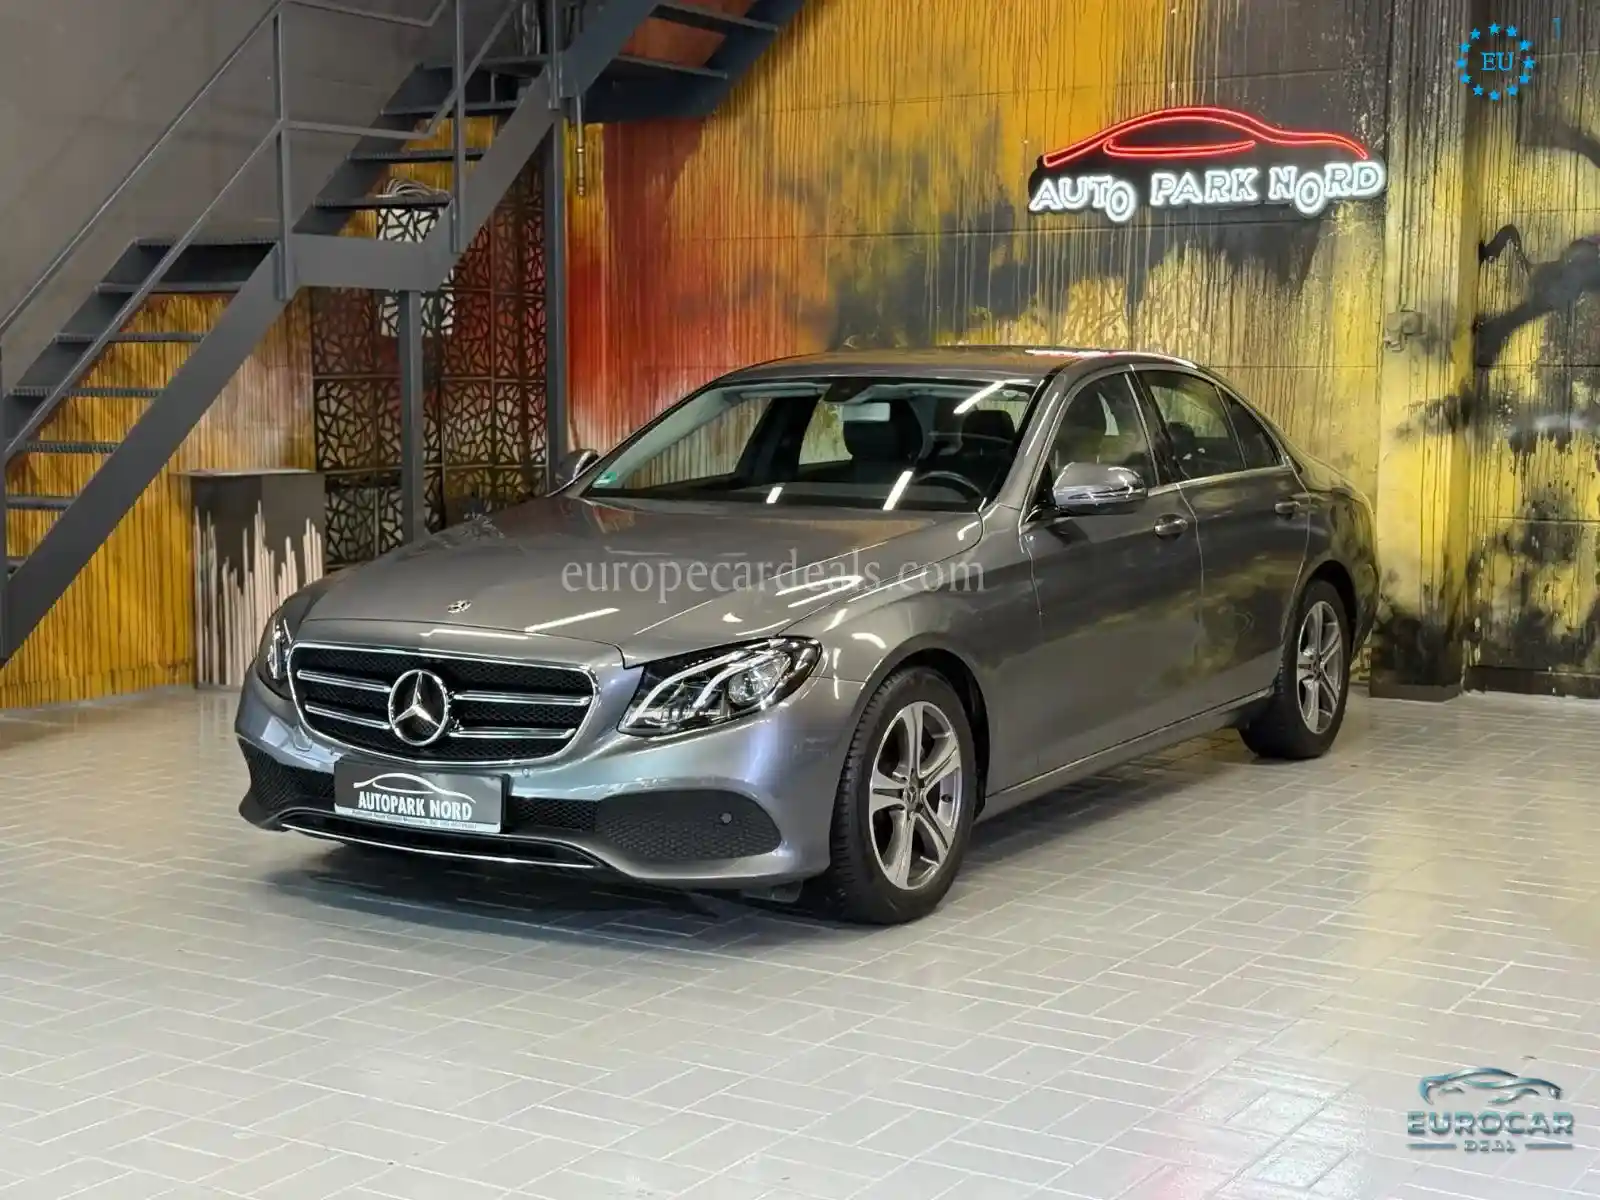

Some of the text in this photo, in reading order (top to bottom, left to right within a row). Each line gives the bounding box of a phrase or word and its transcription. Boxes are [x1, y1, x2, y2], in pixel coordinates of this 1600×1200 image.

[1029, 162, 1386, 223] AUTO PARK NORD
[358, 791, 425, 816] AUTOPARK
[429, 800, 473, 820] NORD
